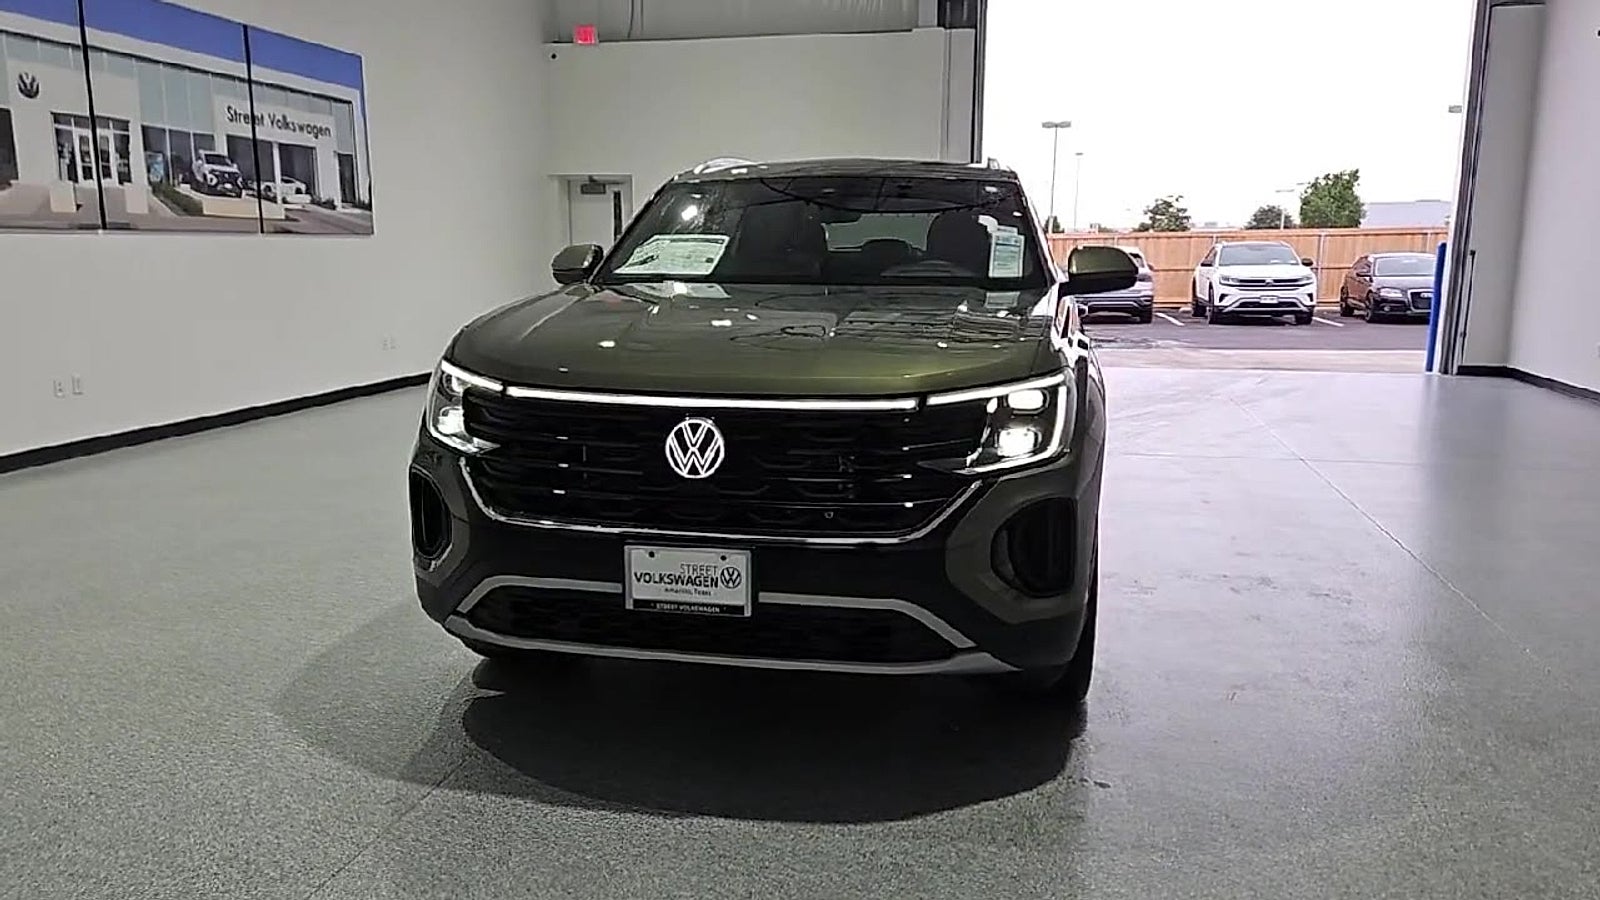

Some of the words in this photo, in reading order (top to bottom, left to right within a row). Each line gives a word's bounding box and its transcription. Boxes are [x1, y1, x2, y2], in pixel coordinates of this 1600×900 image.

[268, 112, 332, 139] Volkswagen
[680, 563, 719, 577] STREET
[634, 571, 719, 588] VOLKSWAGEN
[679, 604, 720, 613] VOLKSWAGEN
